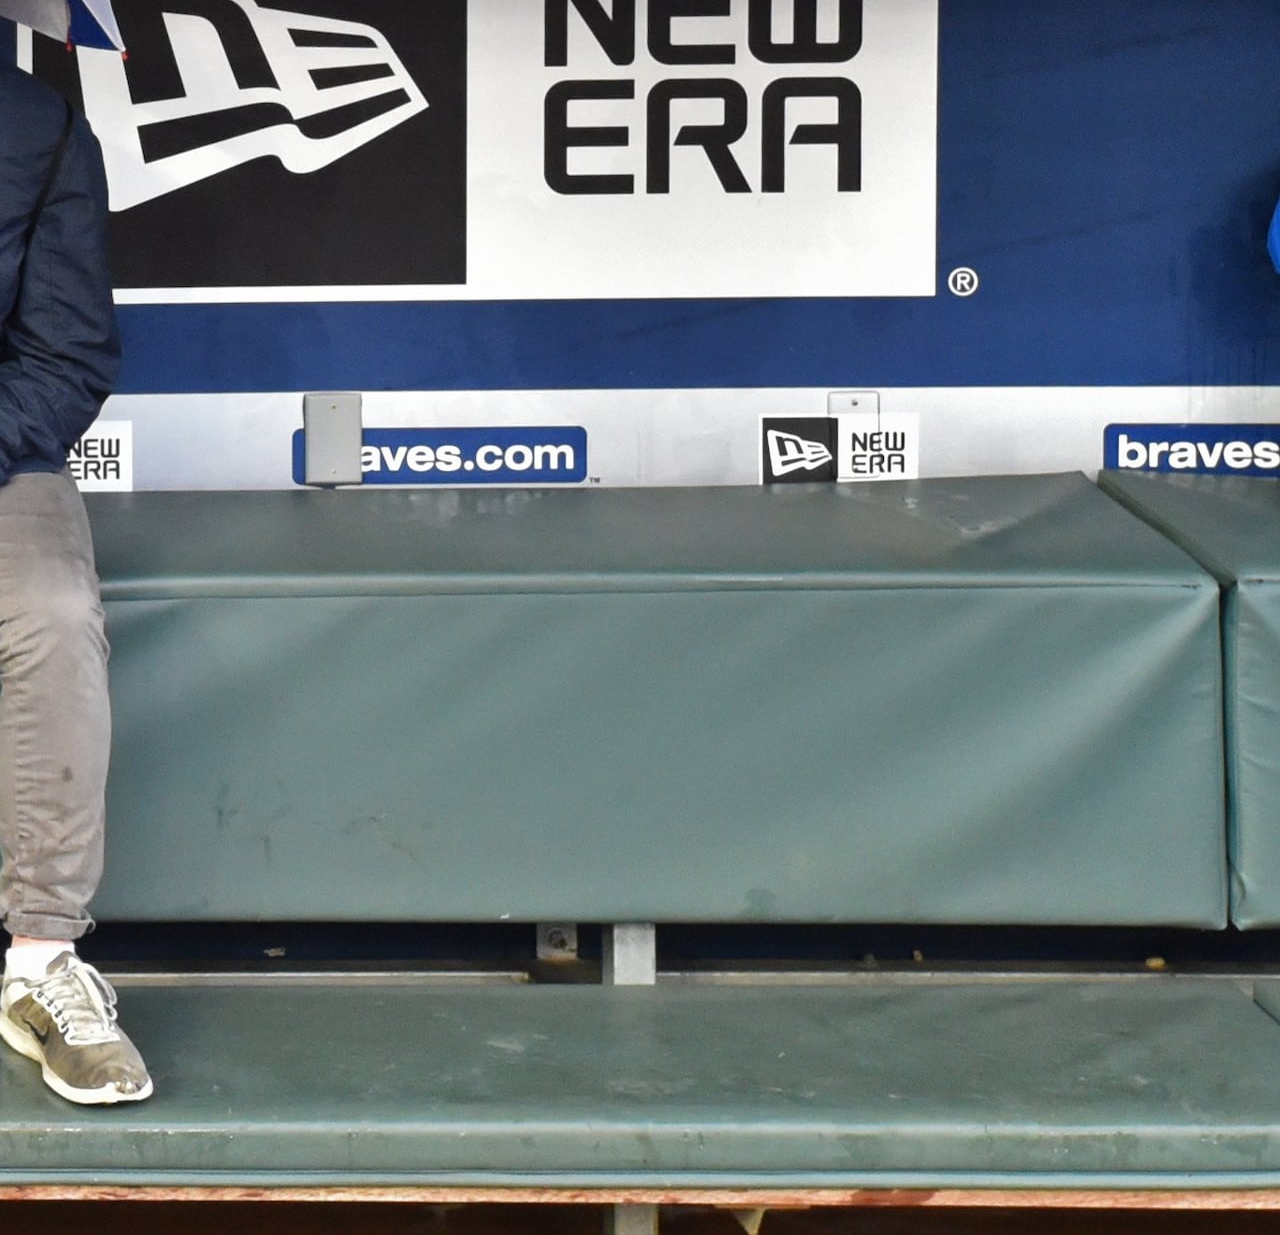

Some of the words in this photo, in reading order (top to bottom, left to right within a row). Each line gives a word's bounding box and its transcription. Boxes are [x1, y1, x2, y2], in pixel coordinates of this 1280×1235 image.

[544, 78, 862, 195] ERA
[67, 438, 120, 458] NEW
[851, 431, 906, 451] NEW
[361, 444, 574, 472] aves.com
[851, 454, 906, 473] ERA
[67, 460, 120, 480] ERA
